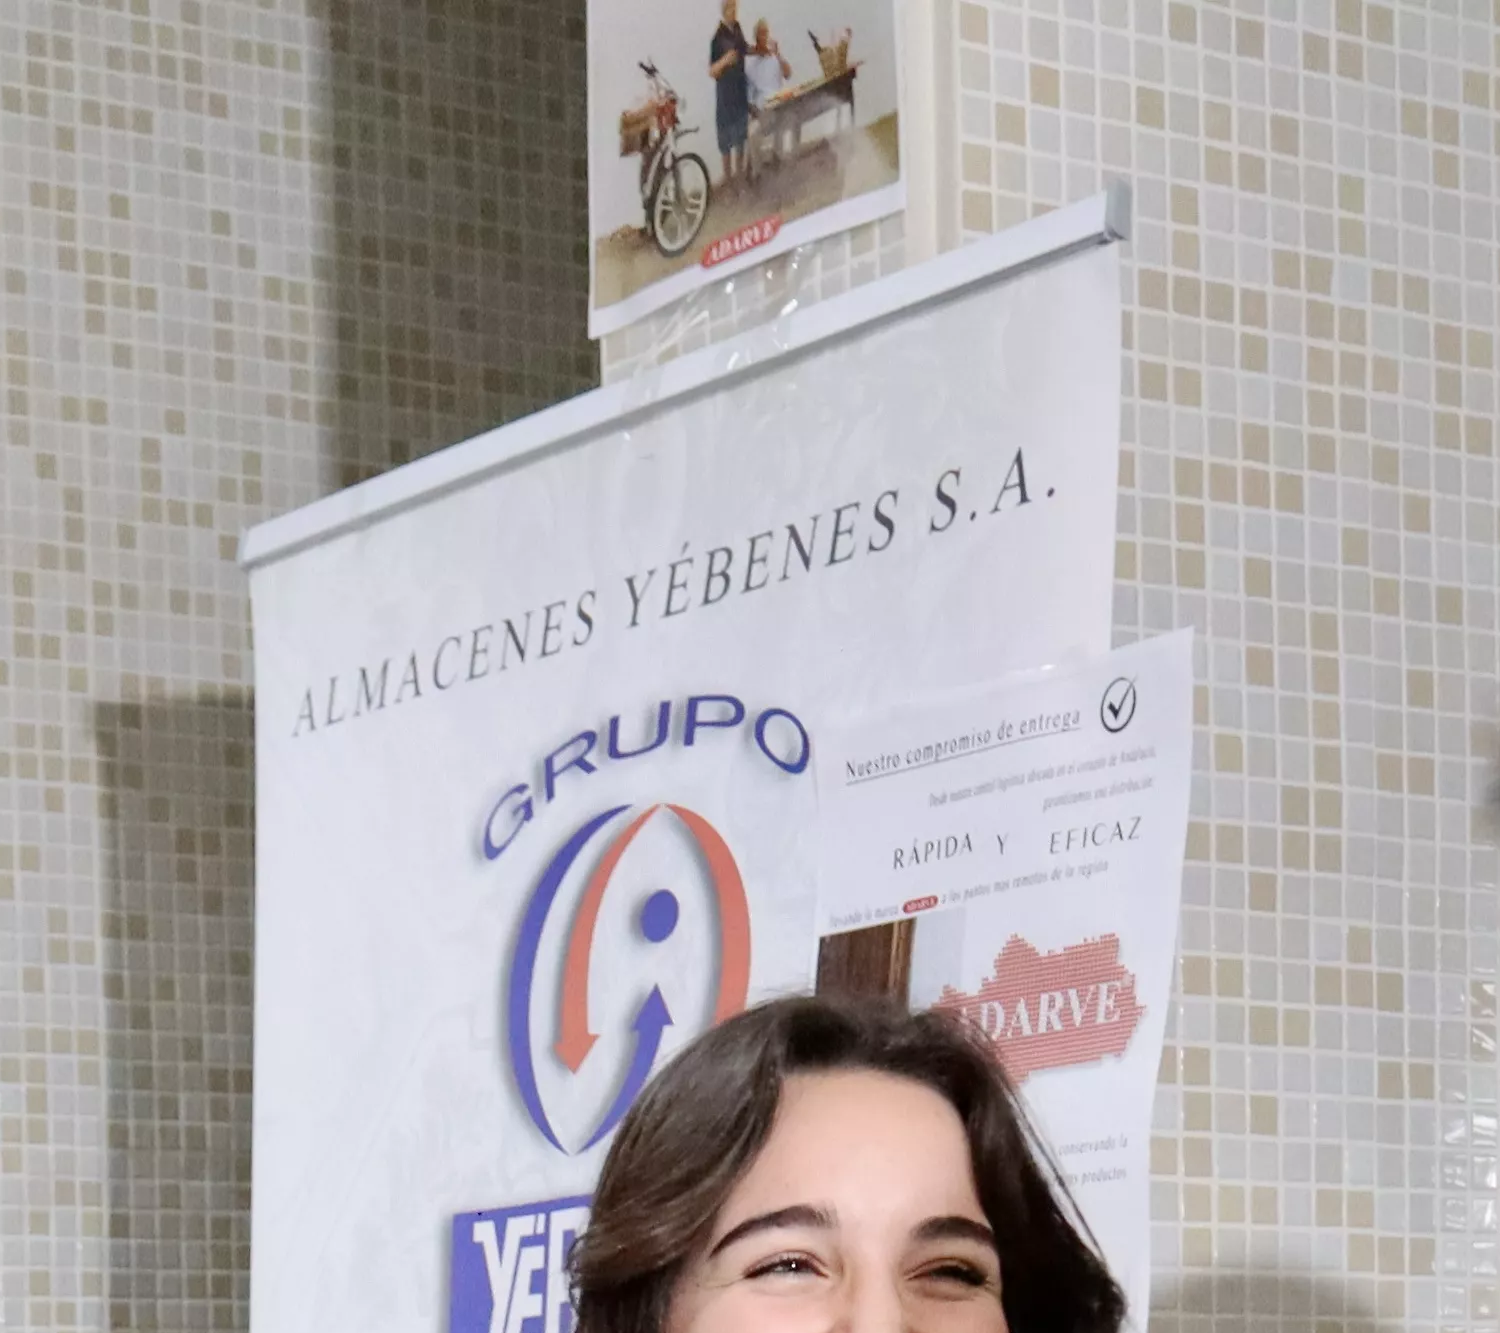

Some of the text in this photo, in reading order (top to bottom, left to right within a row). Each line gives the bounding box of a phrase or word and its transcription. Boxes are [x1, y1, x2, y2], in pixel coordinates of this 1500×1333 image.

[293, 446, 1057, 738] ALMACENES YÉBENES S.A.
[483, 693, 810, 861] GRUPO
[846, 753, 901, 778] Nuestro
[906, 728, 991, 764] compromiso
[997, 720, 1013, 741] de
[1020, 710, 1080, 735] entrega
[893, 816, 1142, 870] RÁPIDA Y EFICAZ
[960, 980, 1122, 1040] DARVE
